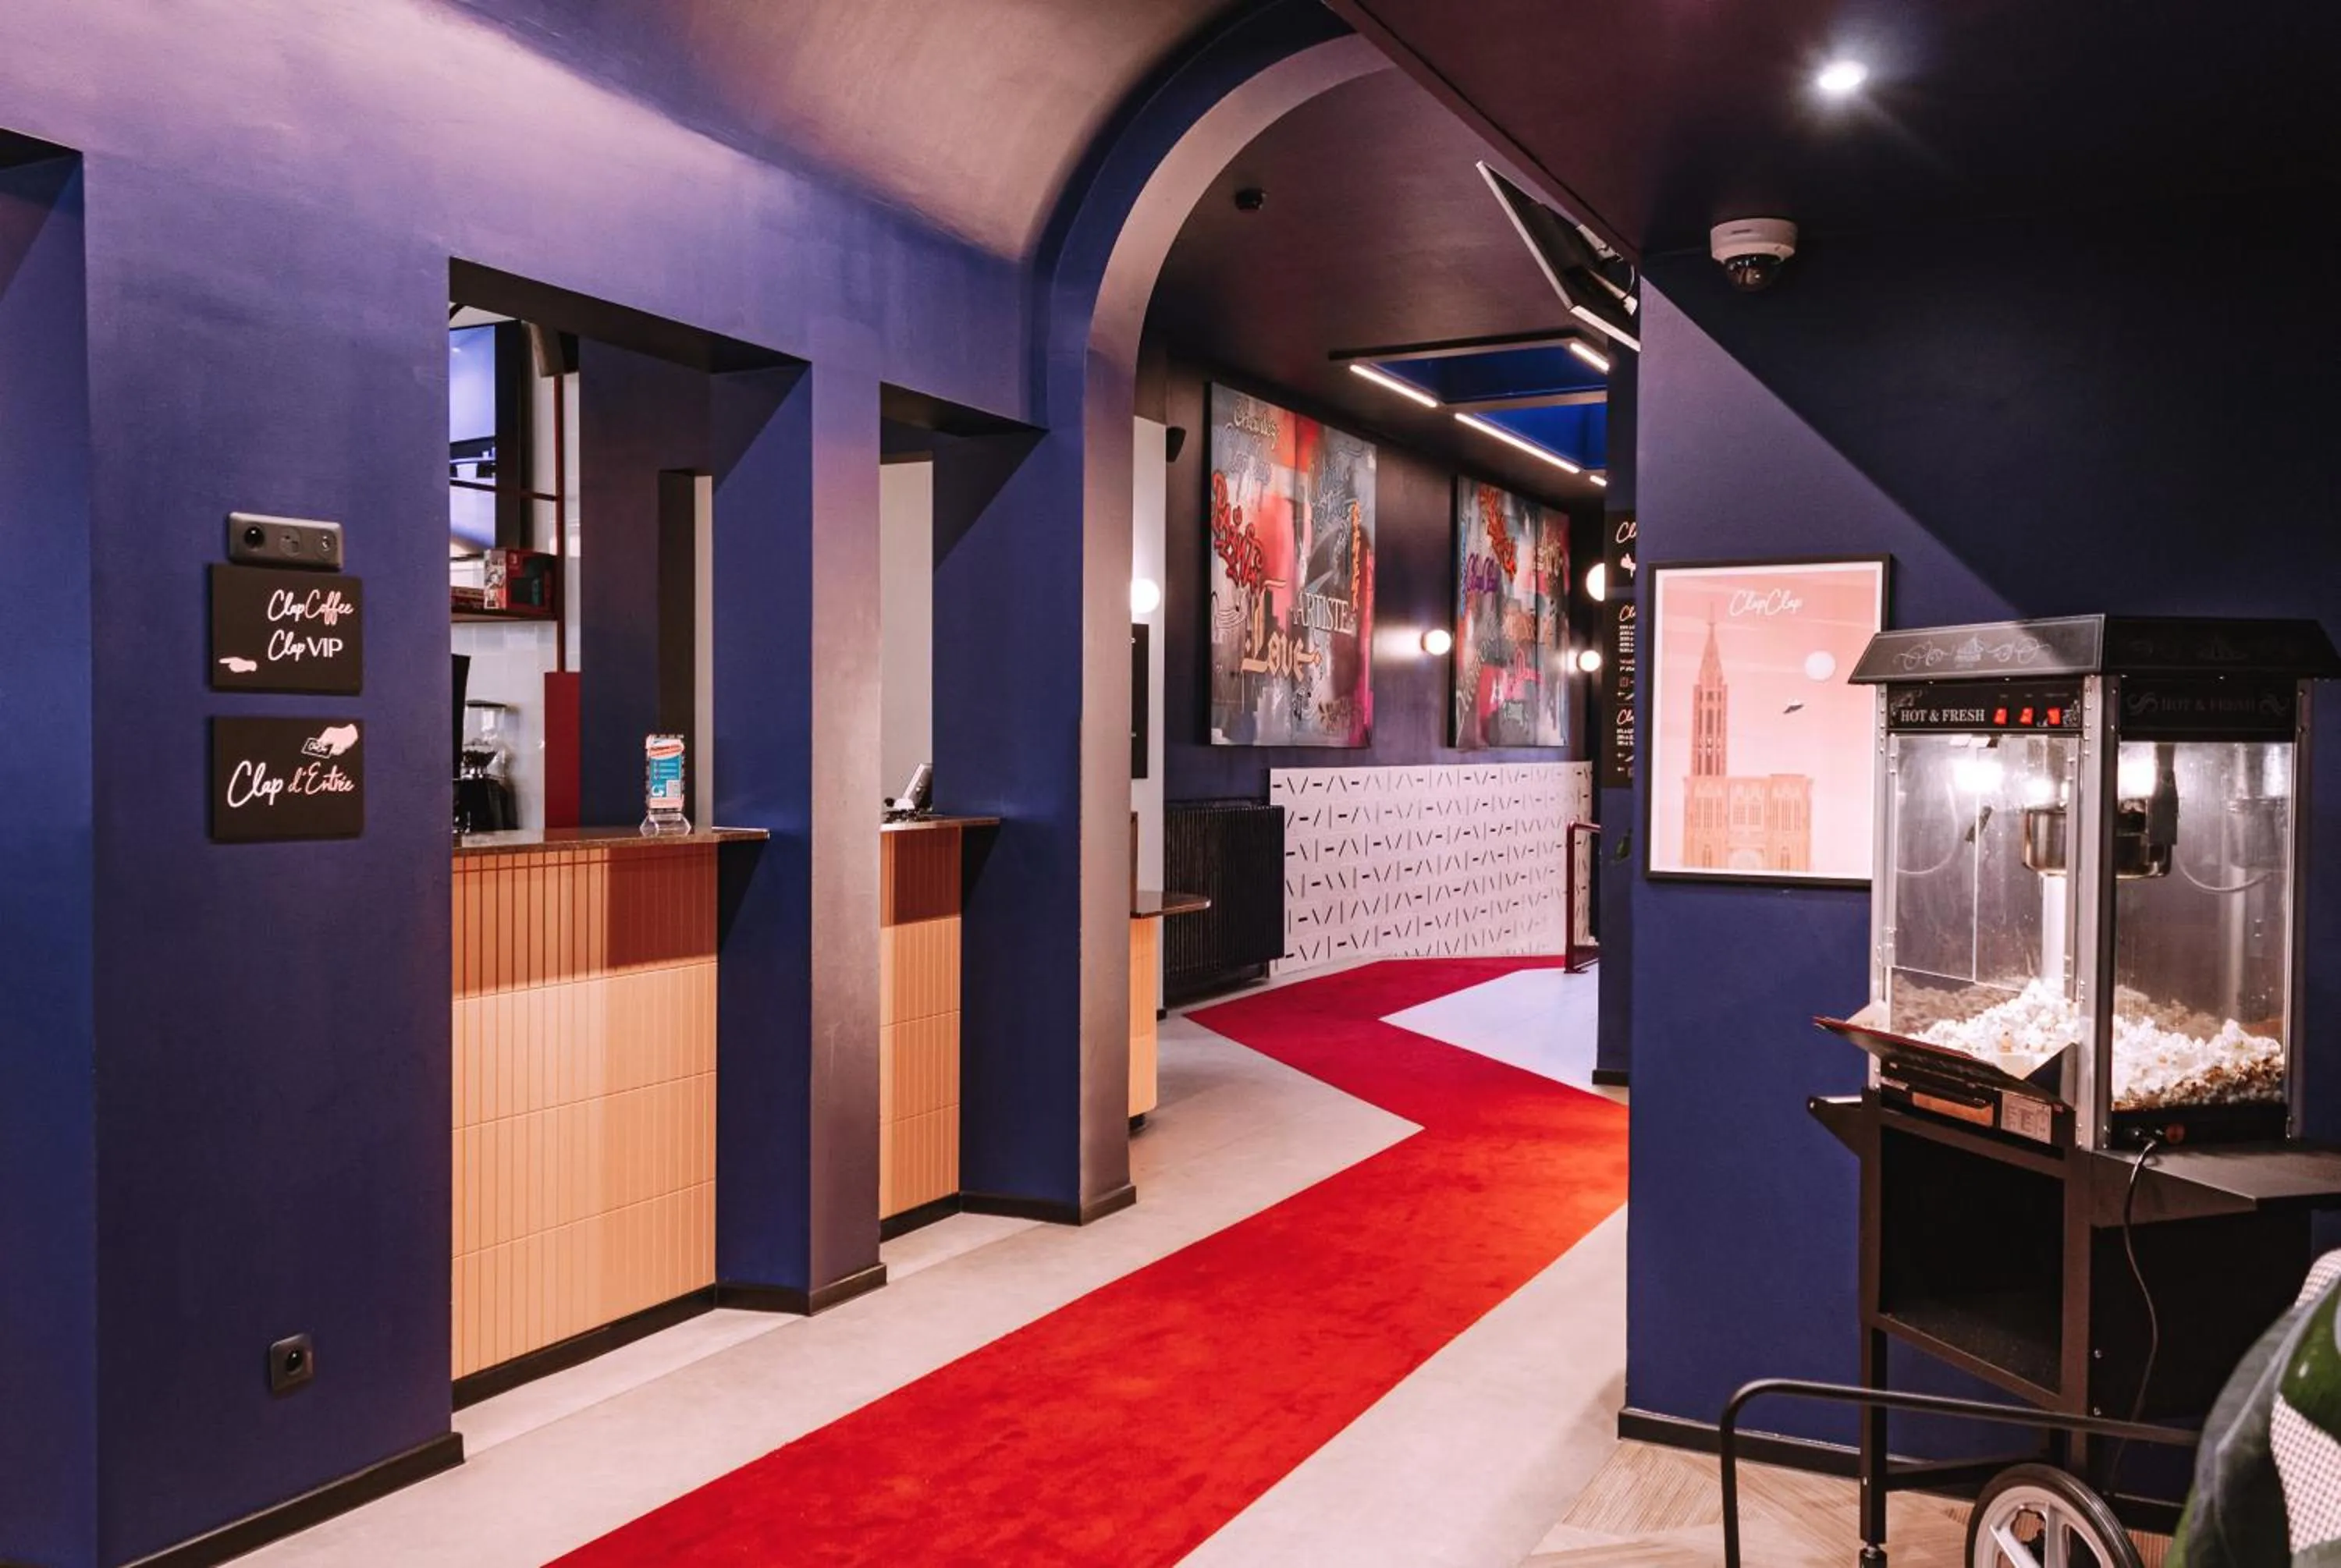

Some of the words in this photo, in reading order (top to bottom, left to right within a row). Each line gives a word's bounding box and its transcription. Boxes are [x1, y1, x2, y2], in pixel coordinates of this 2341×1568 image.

[1615, 521, 1637, 544] Cl
[267, 589, 305, 622] Clap
[304, 589, 354, 626] Coffee
[1291, 591, 1353, 636] ARTISTE
[267, 629, 305, 662] Clap
[306, 637, 343, 658] VIP
[1901, 708, 1927, 722] HOT
[1928, 708, 1939, 722] &
[1941, 708, 1985, 722] FRESH
[227, 760, 284, 808] Clap
